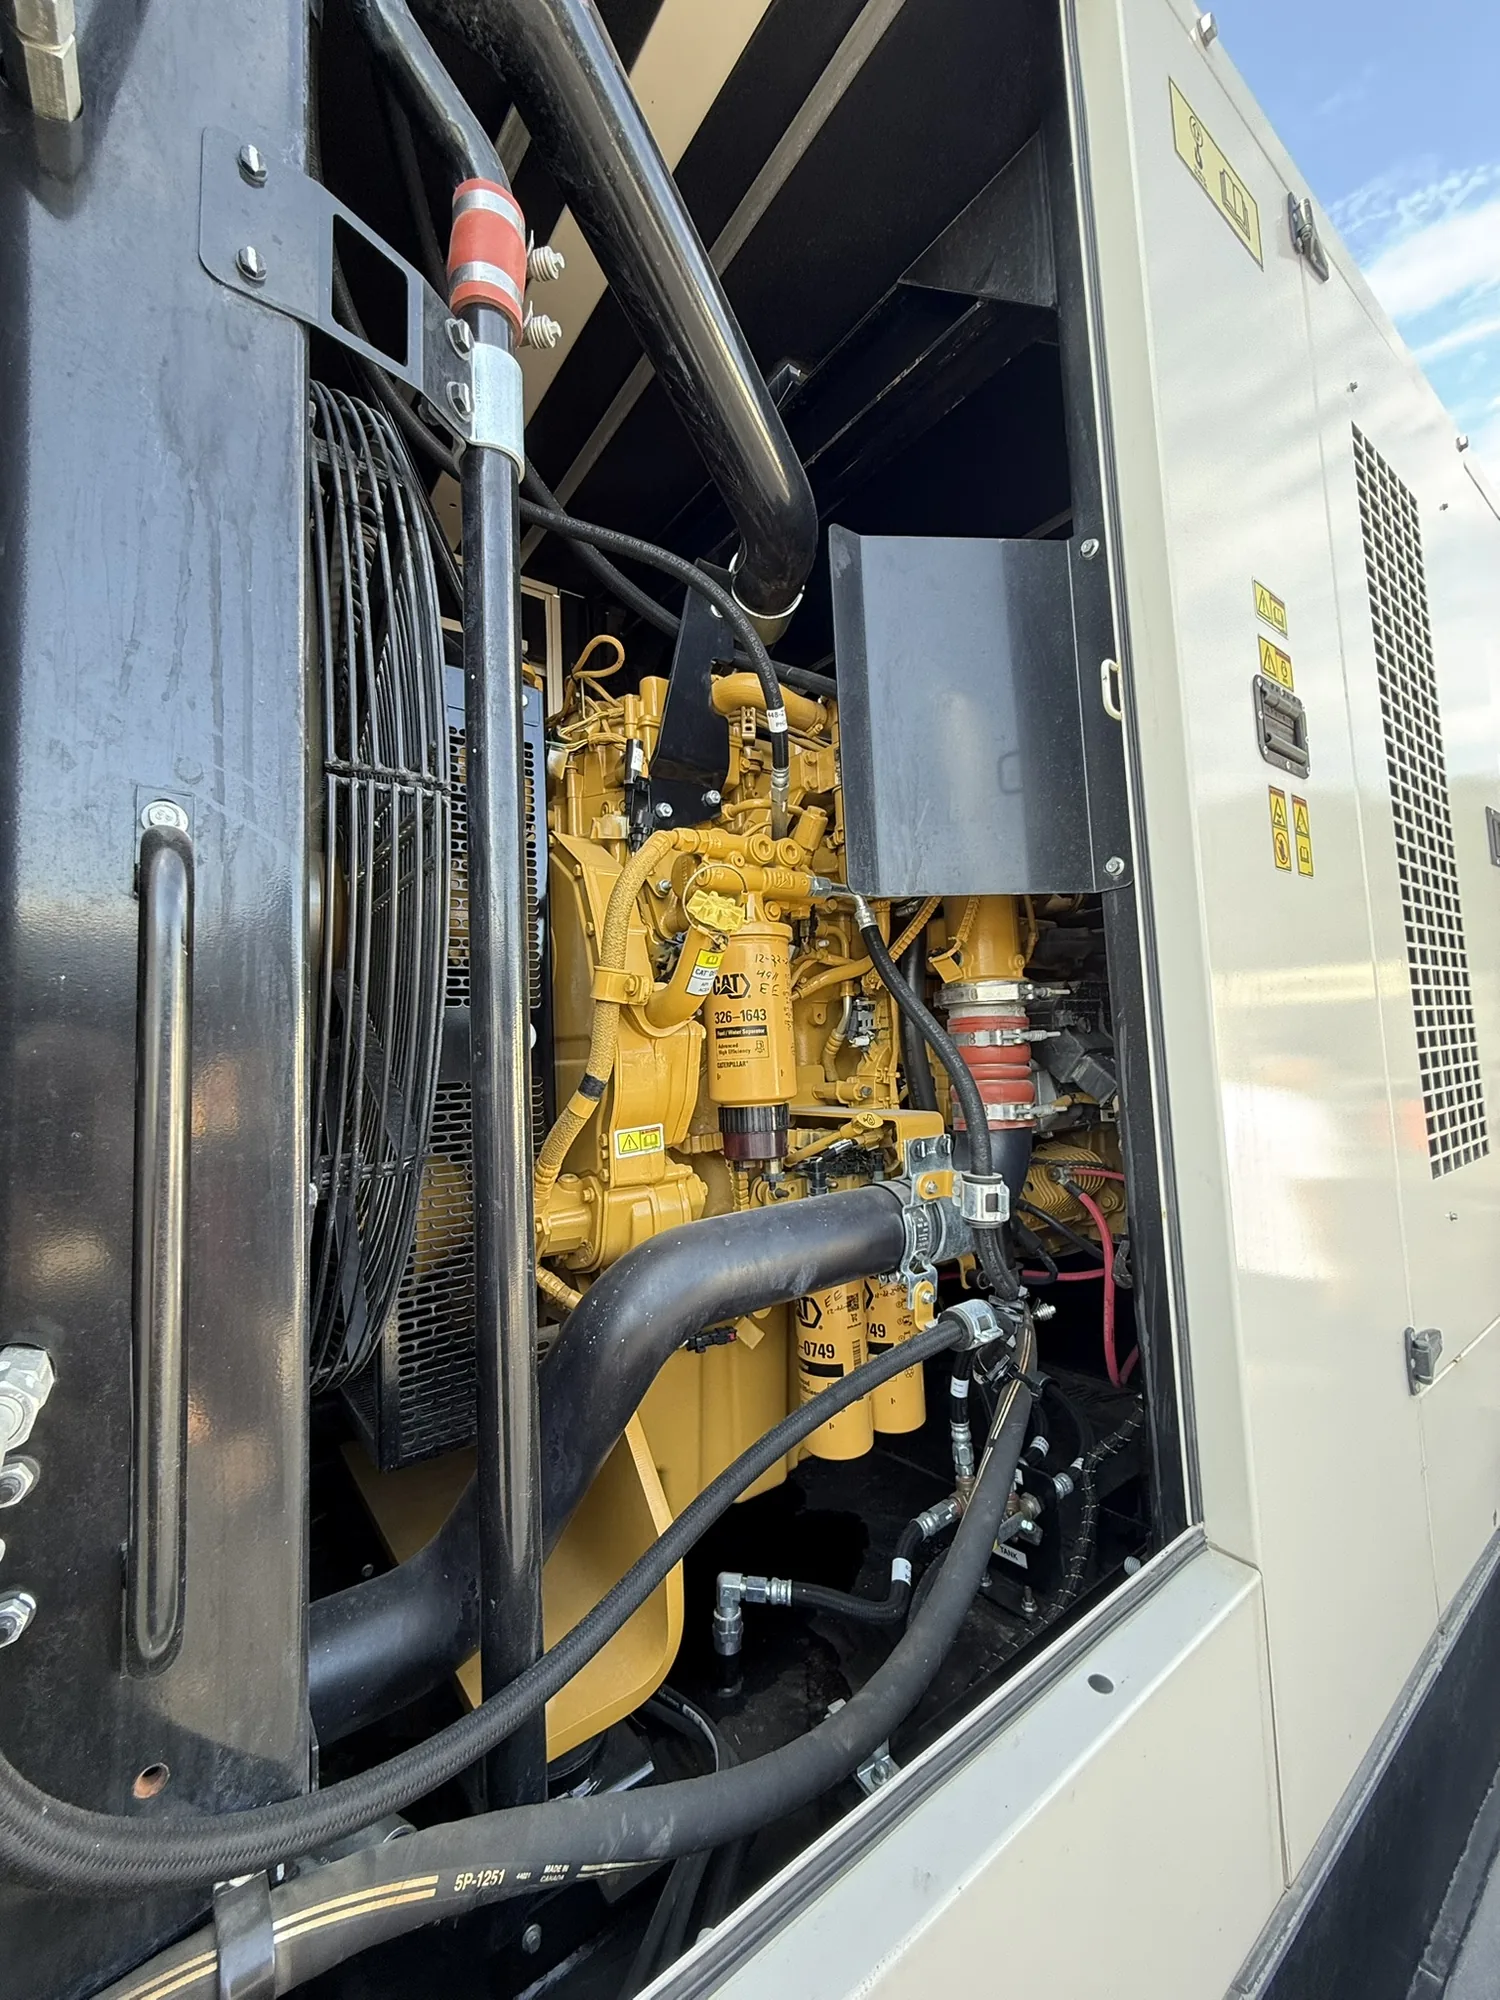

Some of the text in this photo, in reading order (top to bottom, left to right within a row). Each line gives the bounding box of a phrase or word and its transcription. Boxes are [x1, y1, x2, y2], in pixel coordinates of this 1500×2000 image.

[713, 973, 740, 996] CAT
[714, 1008, 767, 1024] 326-1643
[742, 1028, 766, 1036] Separator
[1000, 1545, 1020, 1562] TANK
[453, 1868, 506, 1892] 5P-1251
[543, 1864, 562, 1874] MADE
[562, 1864, 570, 1873] IN
[540, 1874, 565, 1883] CANADA
